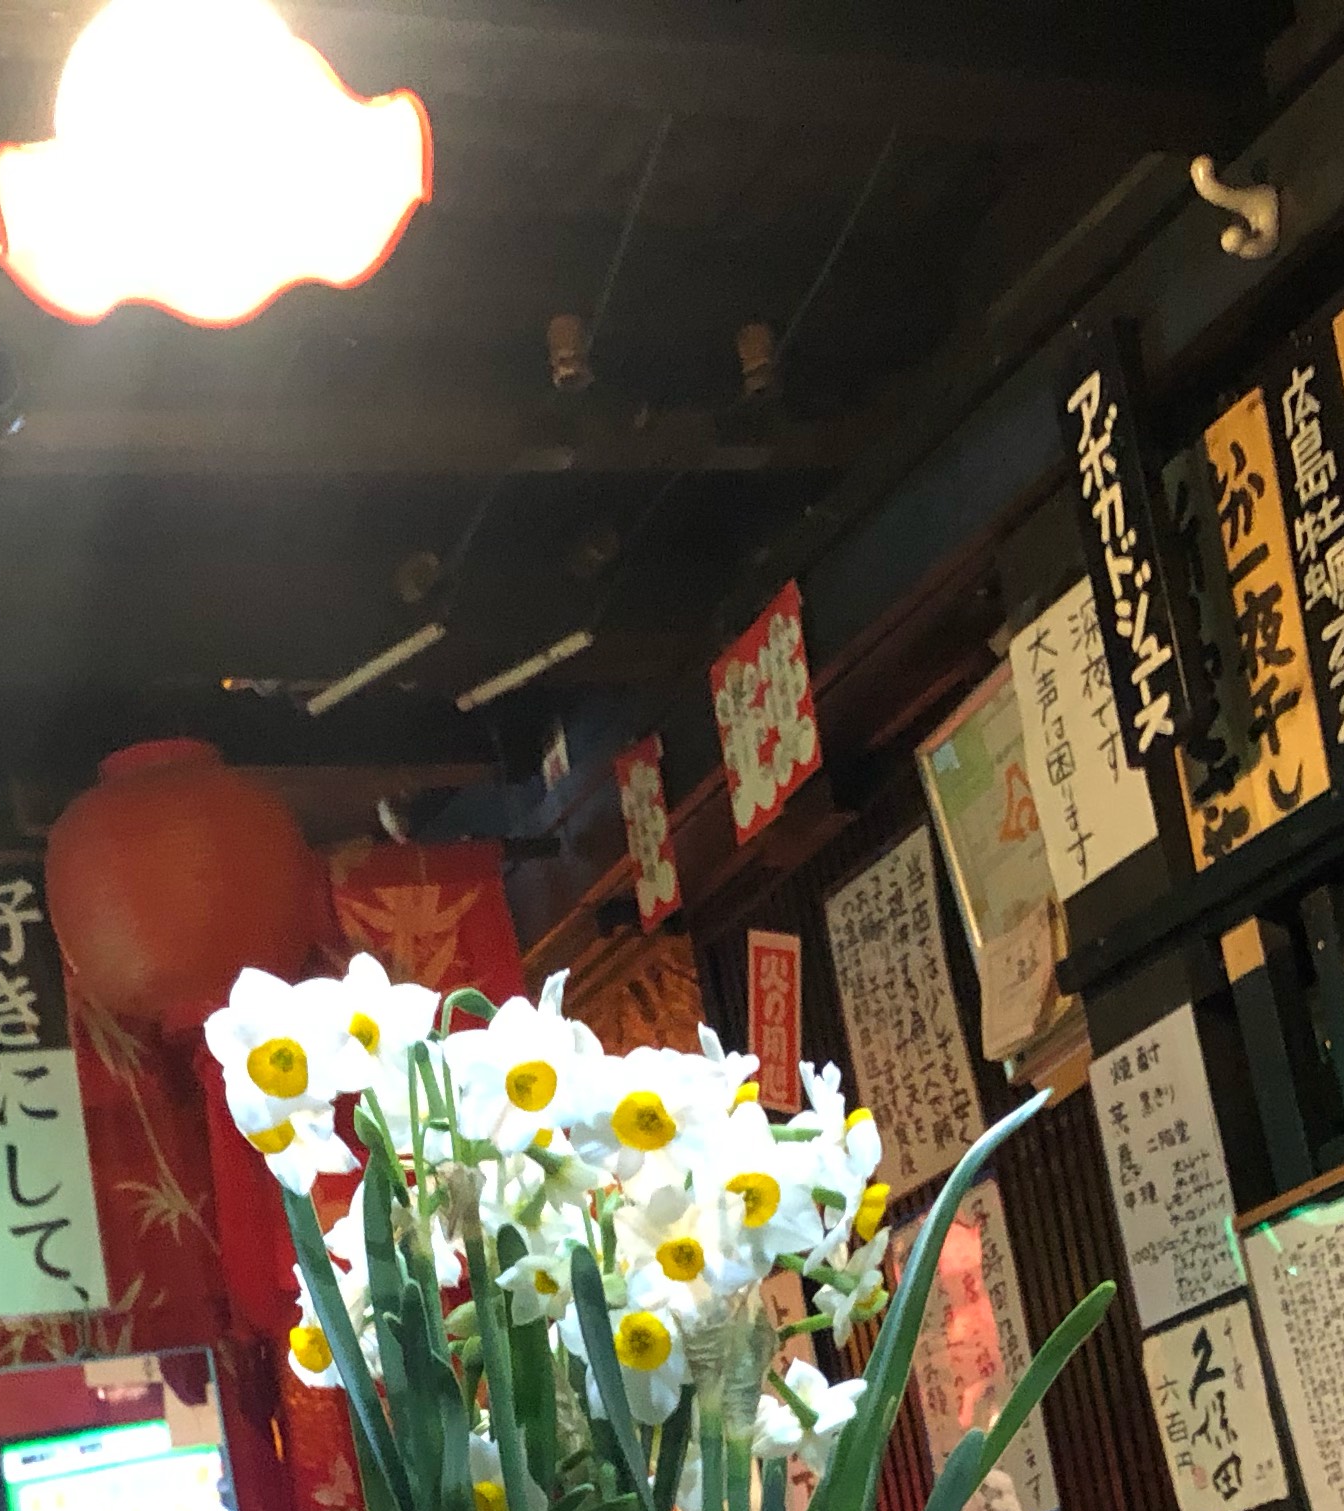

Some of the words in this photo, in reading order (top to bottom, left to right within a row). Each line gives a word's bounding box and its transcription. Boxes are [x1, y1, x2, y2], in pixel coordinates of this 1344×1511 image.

[1066, 370, 1174, 754] アボカドジュース
[1026, 627, 1094, 881] 大声は困ります
